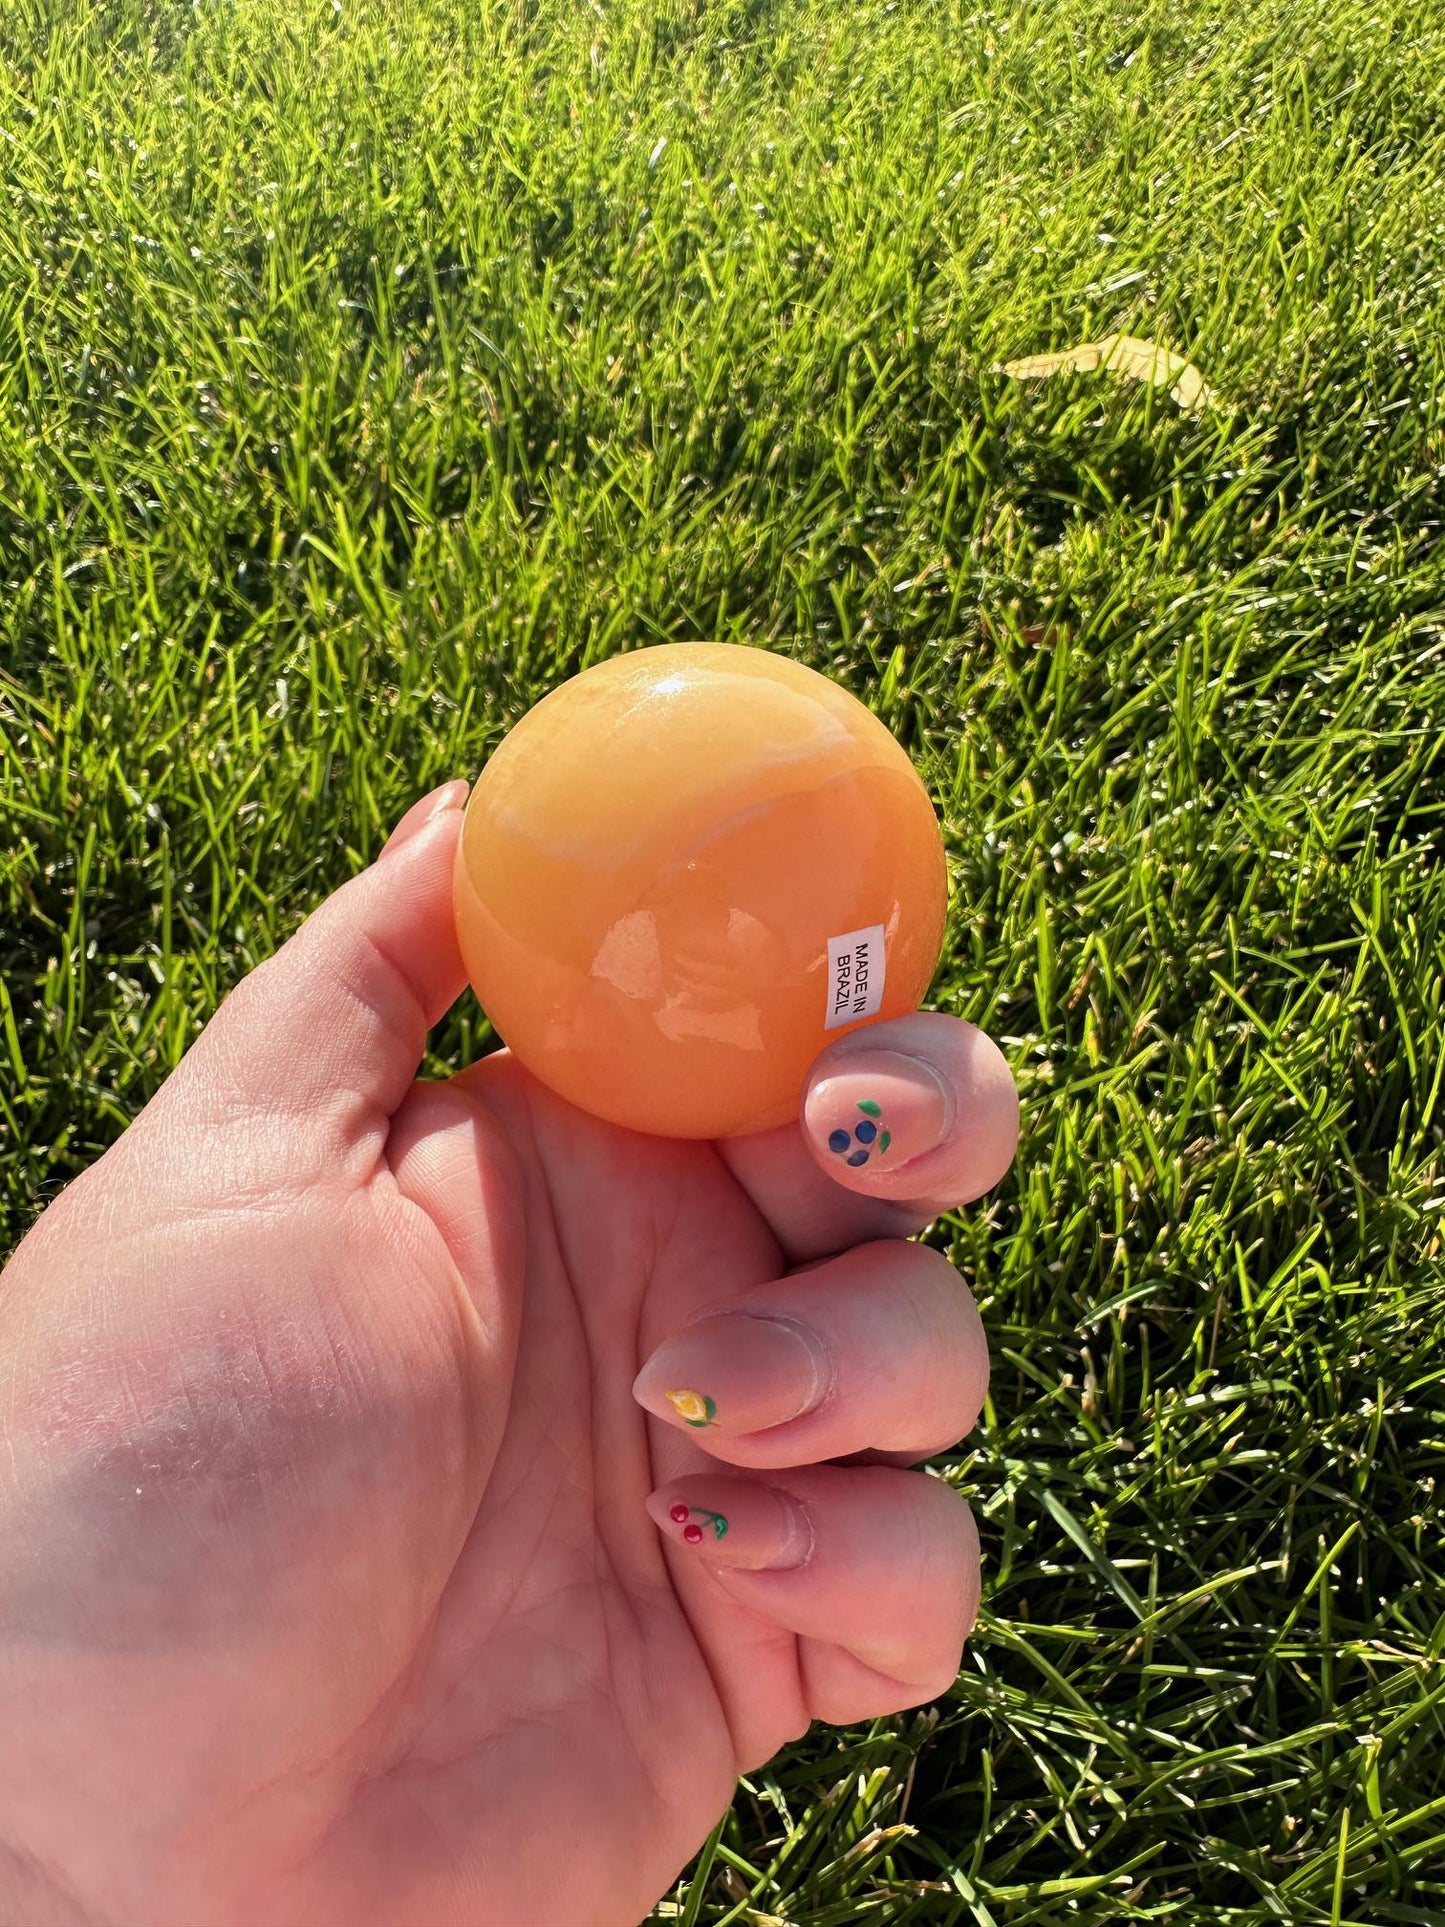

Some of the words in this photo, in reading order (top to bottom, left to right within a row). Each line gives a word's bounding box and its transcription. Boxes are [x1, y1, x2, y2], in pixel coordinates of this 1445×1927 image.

[834, 954, 851, 1015] BRAZIL
[854, 943, 869, 994] MADE
[852, 996, 867, 1014] IN
